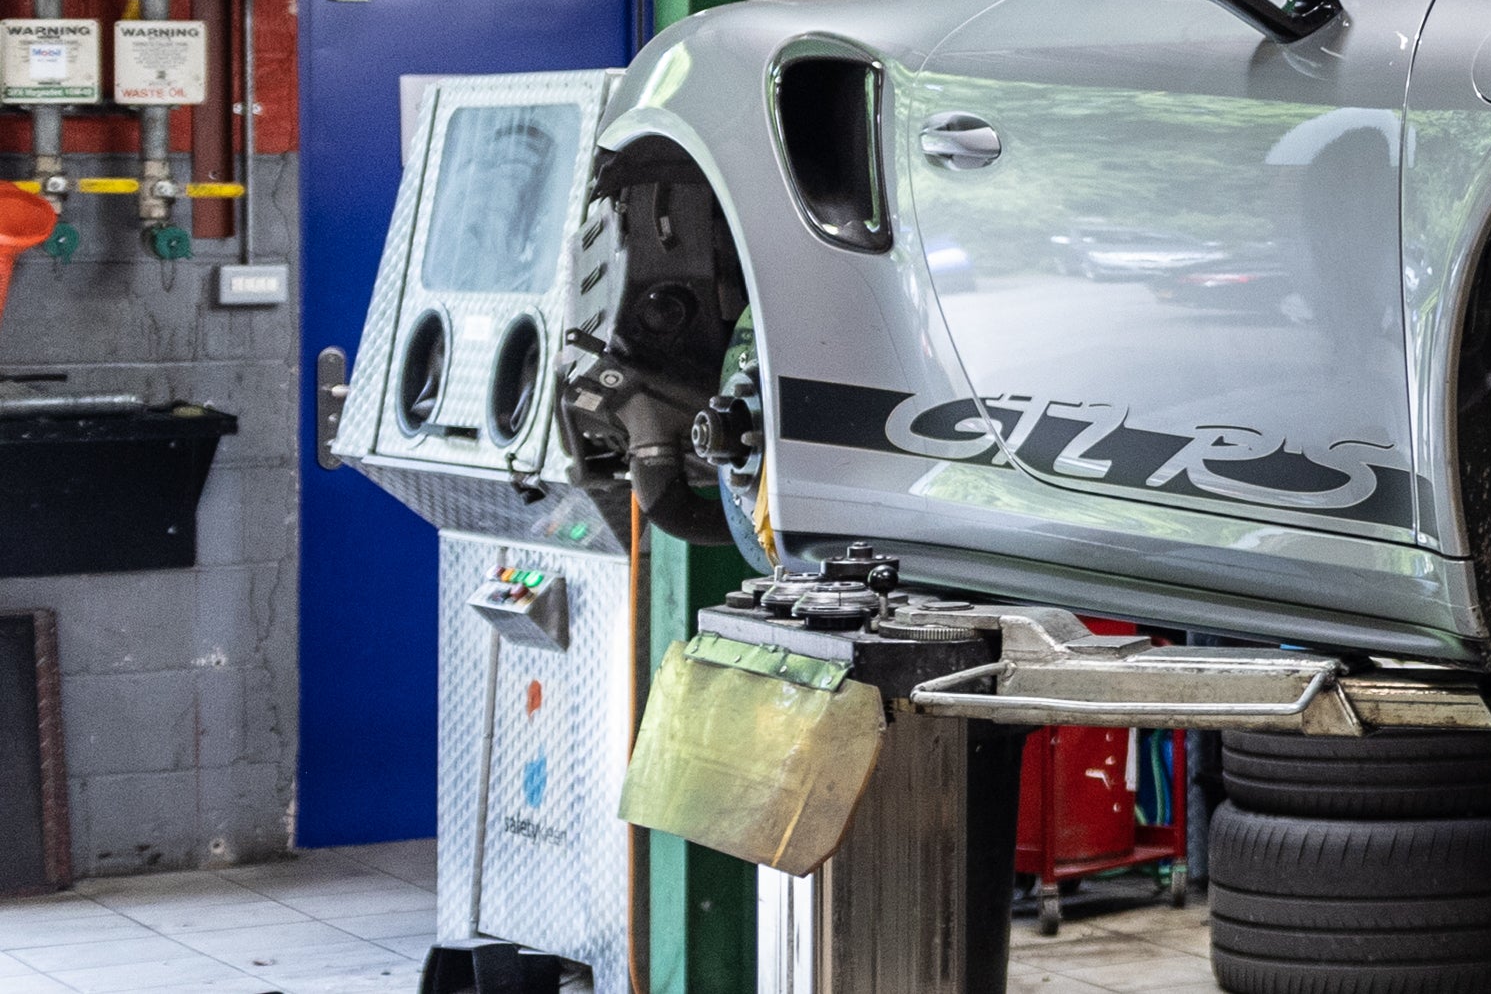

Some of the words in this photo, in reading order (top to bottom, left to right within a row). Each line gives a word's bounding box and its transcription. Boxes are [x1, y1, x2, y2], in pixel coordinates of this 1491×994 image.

[7, 26, 91, 36] WARNING
[120, 28, 200, 38] WARNING
[121, 88, 164, 99] WASTE
[169, 87, 187, 98] OIL
[1146, 424, 1394, 509] RS
